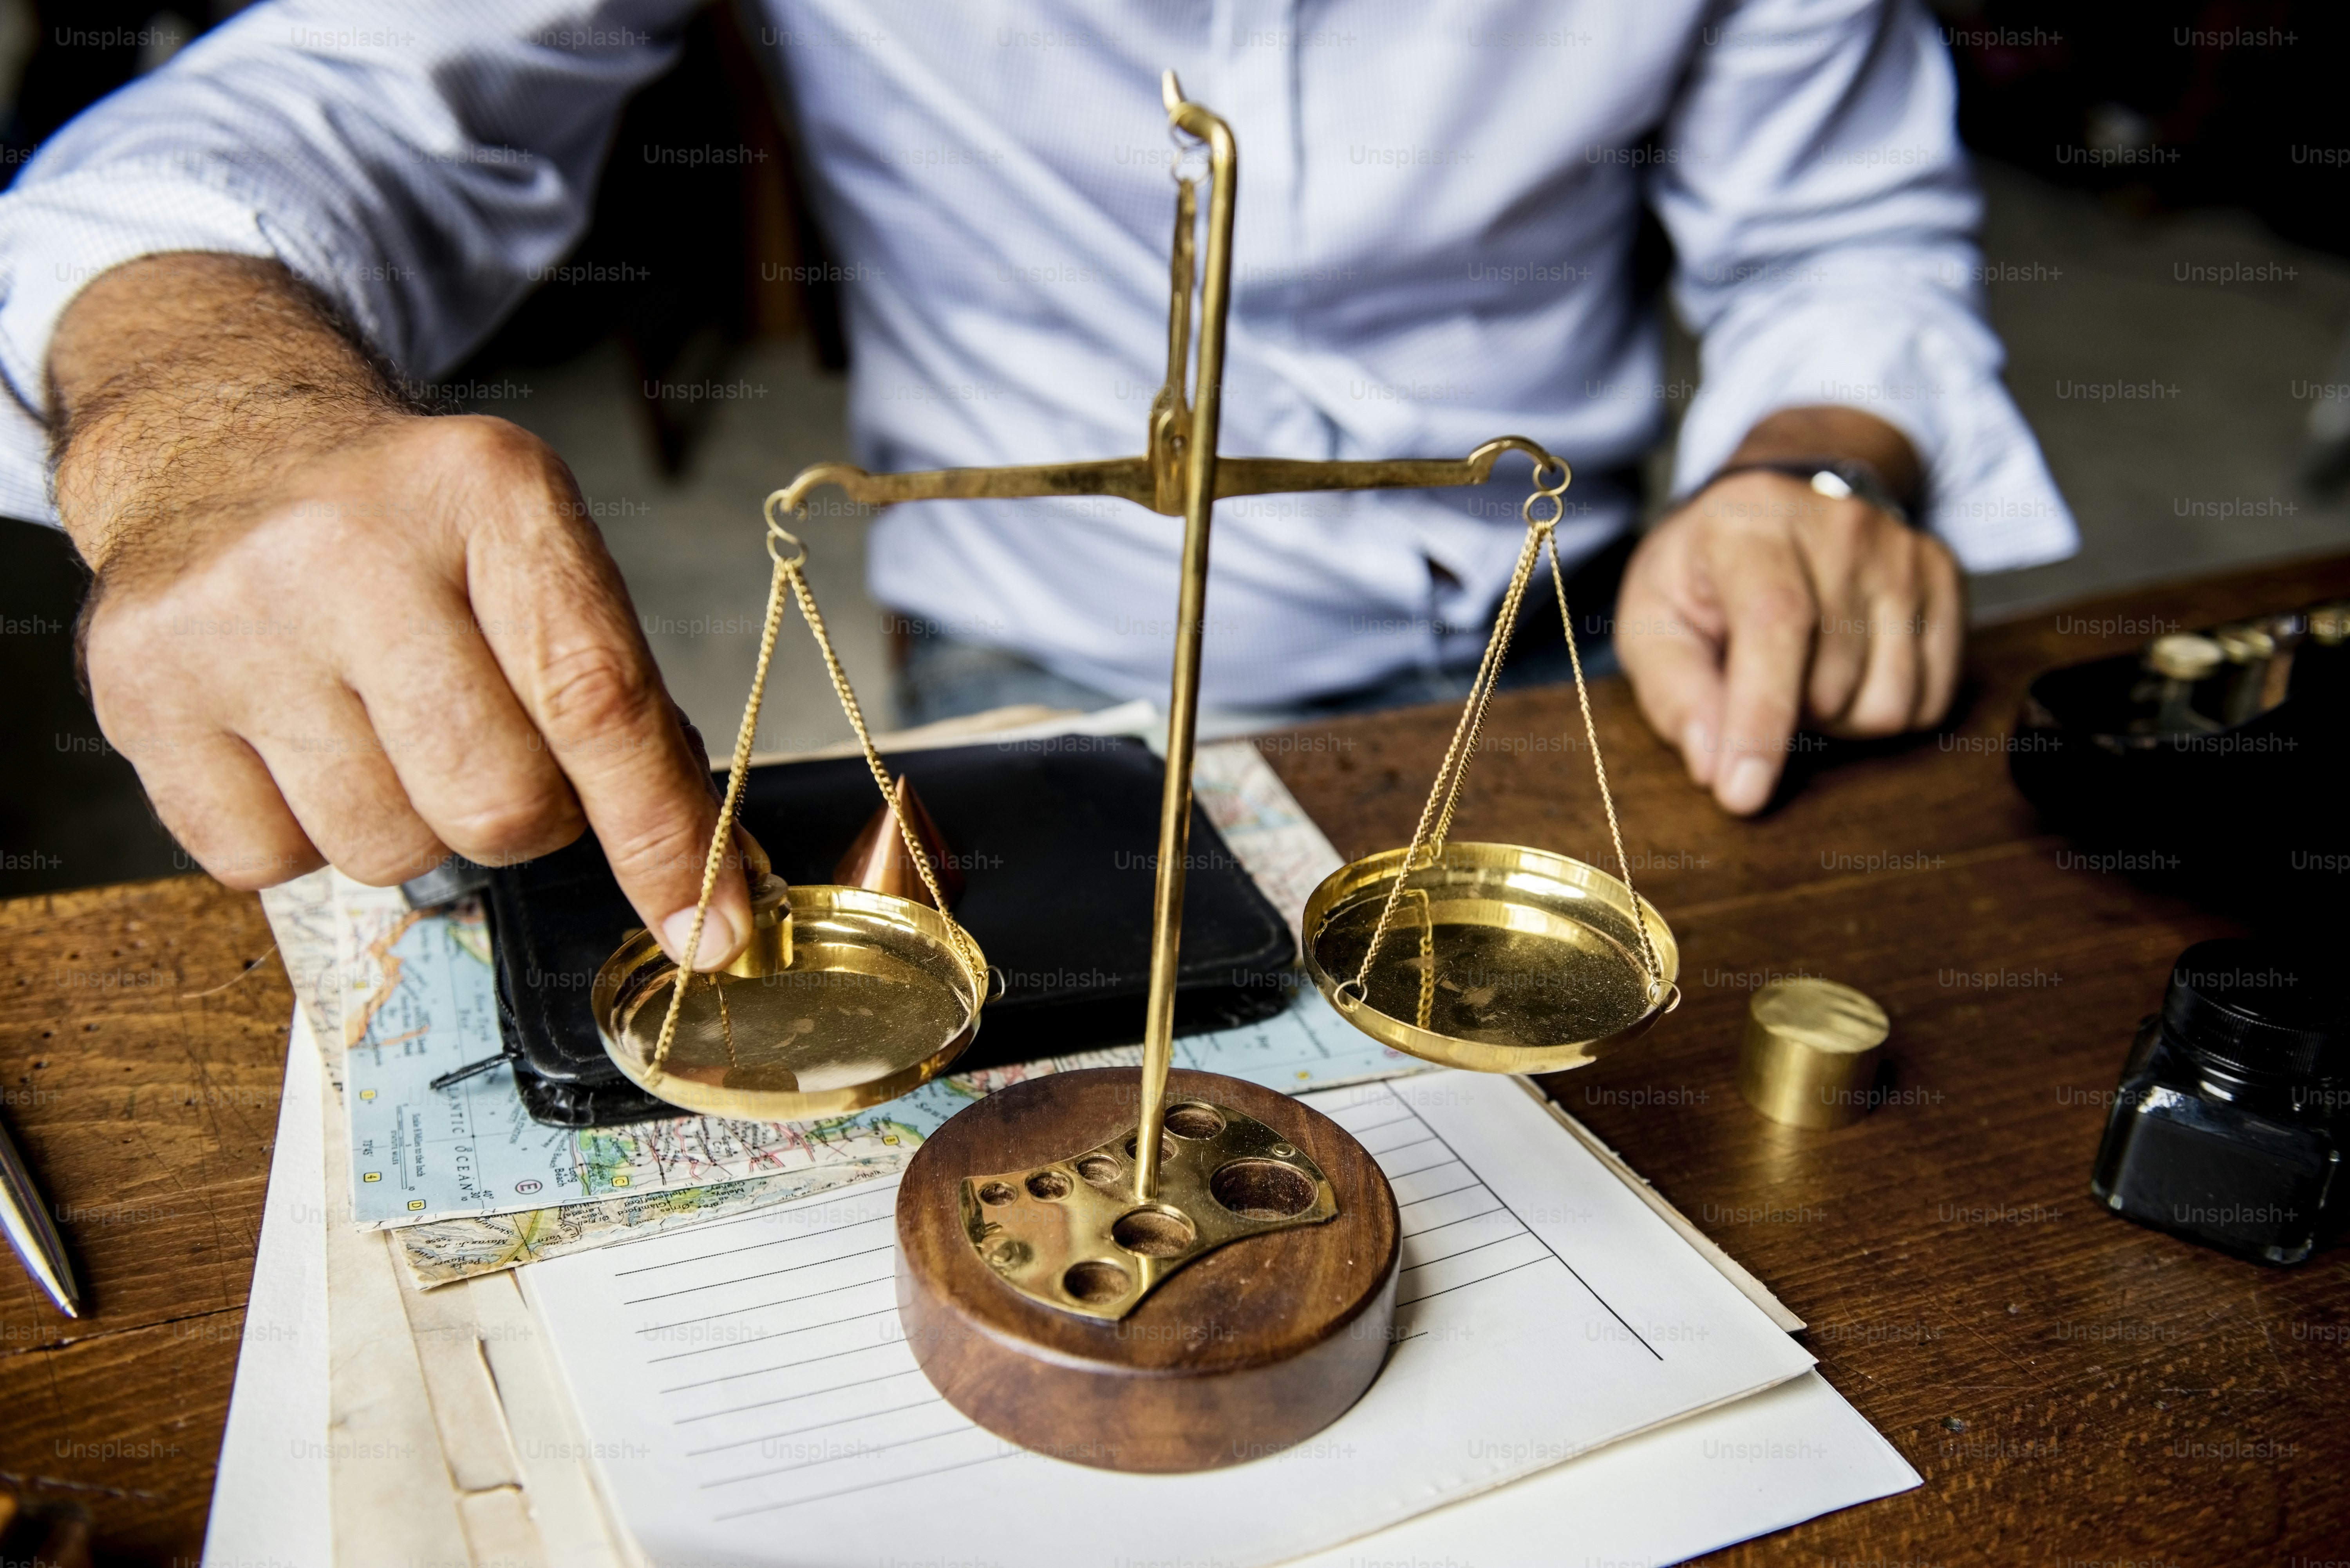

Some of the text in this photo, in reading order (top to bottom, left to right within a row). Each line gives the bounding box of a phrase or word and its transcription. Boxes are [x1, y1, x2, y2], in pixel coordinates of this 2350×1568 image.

[415, 1155, 424, 1163] the
[416, 1165, 425, 1177] Inch
[454, 1145, 473, 1191] OCEAN
[554, 1168, 567, 1188] Beach
[568, 1168, 578, 1183] Long
[715, 1187, 745, 1197] Meløy
[563, 1207, 600, 1219] Lønsdal
[617, 1201, 666, 1216] Glåmfjord
[660, 1203, 690, 1213] Ørnes
[577, 1218, 596, 1227] Fjell
[537, 1234, 563, 1243] Vatn
[430, 1256, 465, 1267] Haure
[449, 1257, 481, 1269] Peske
